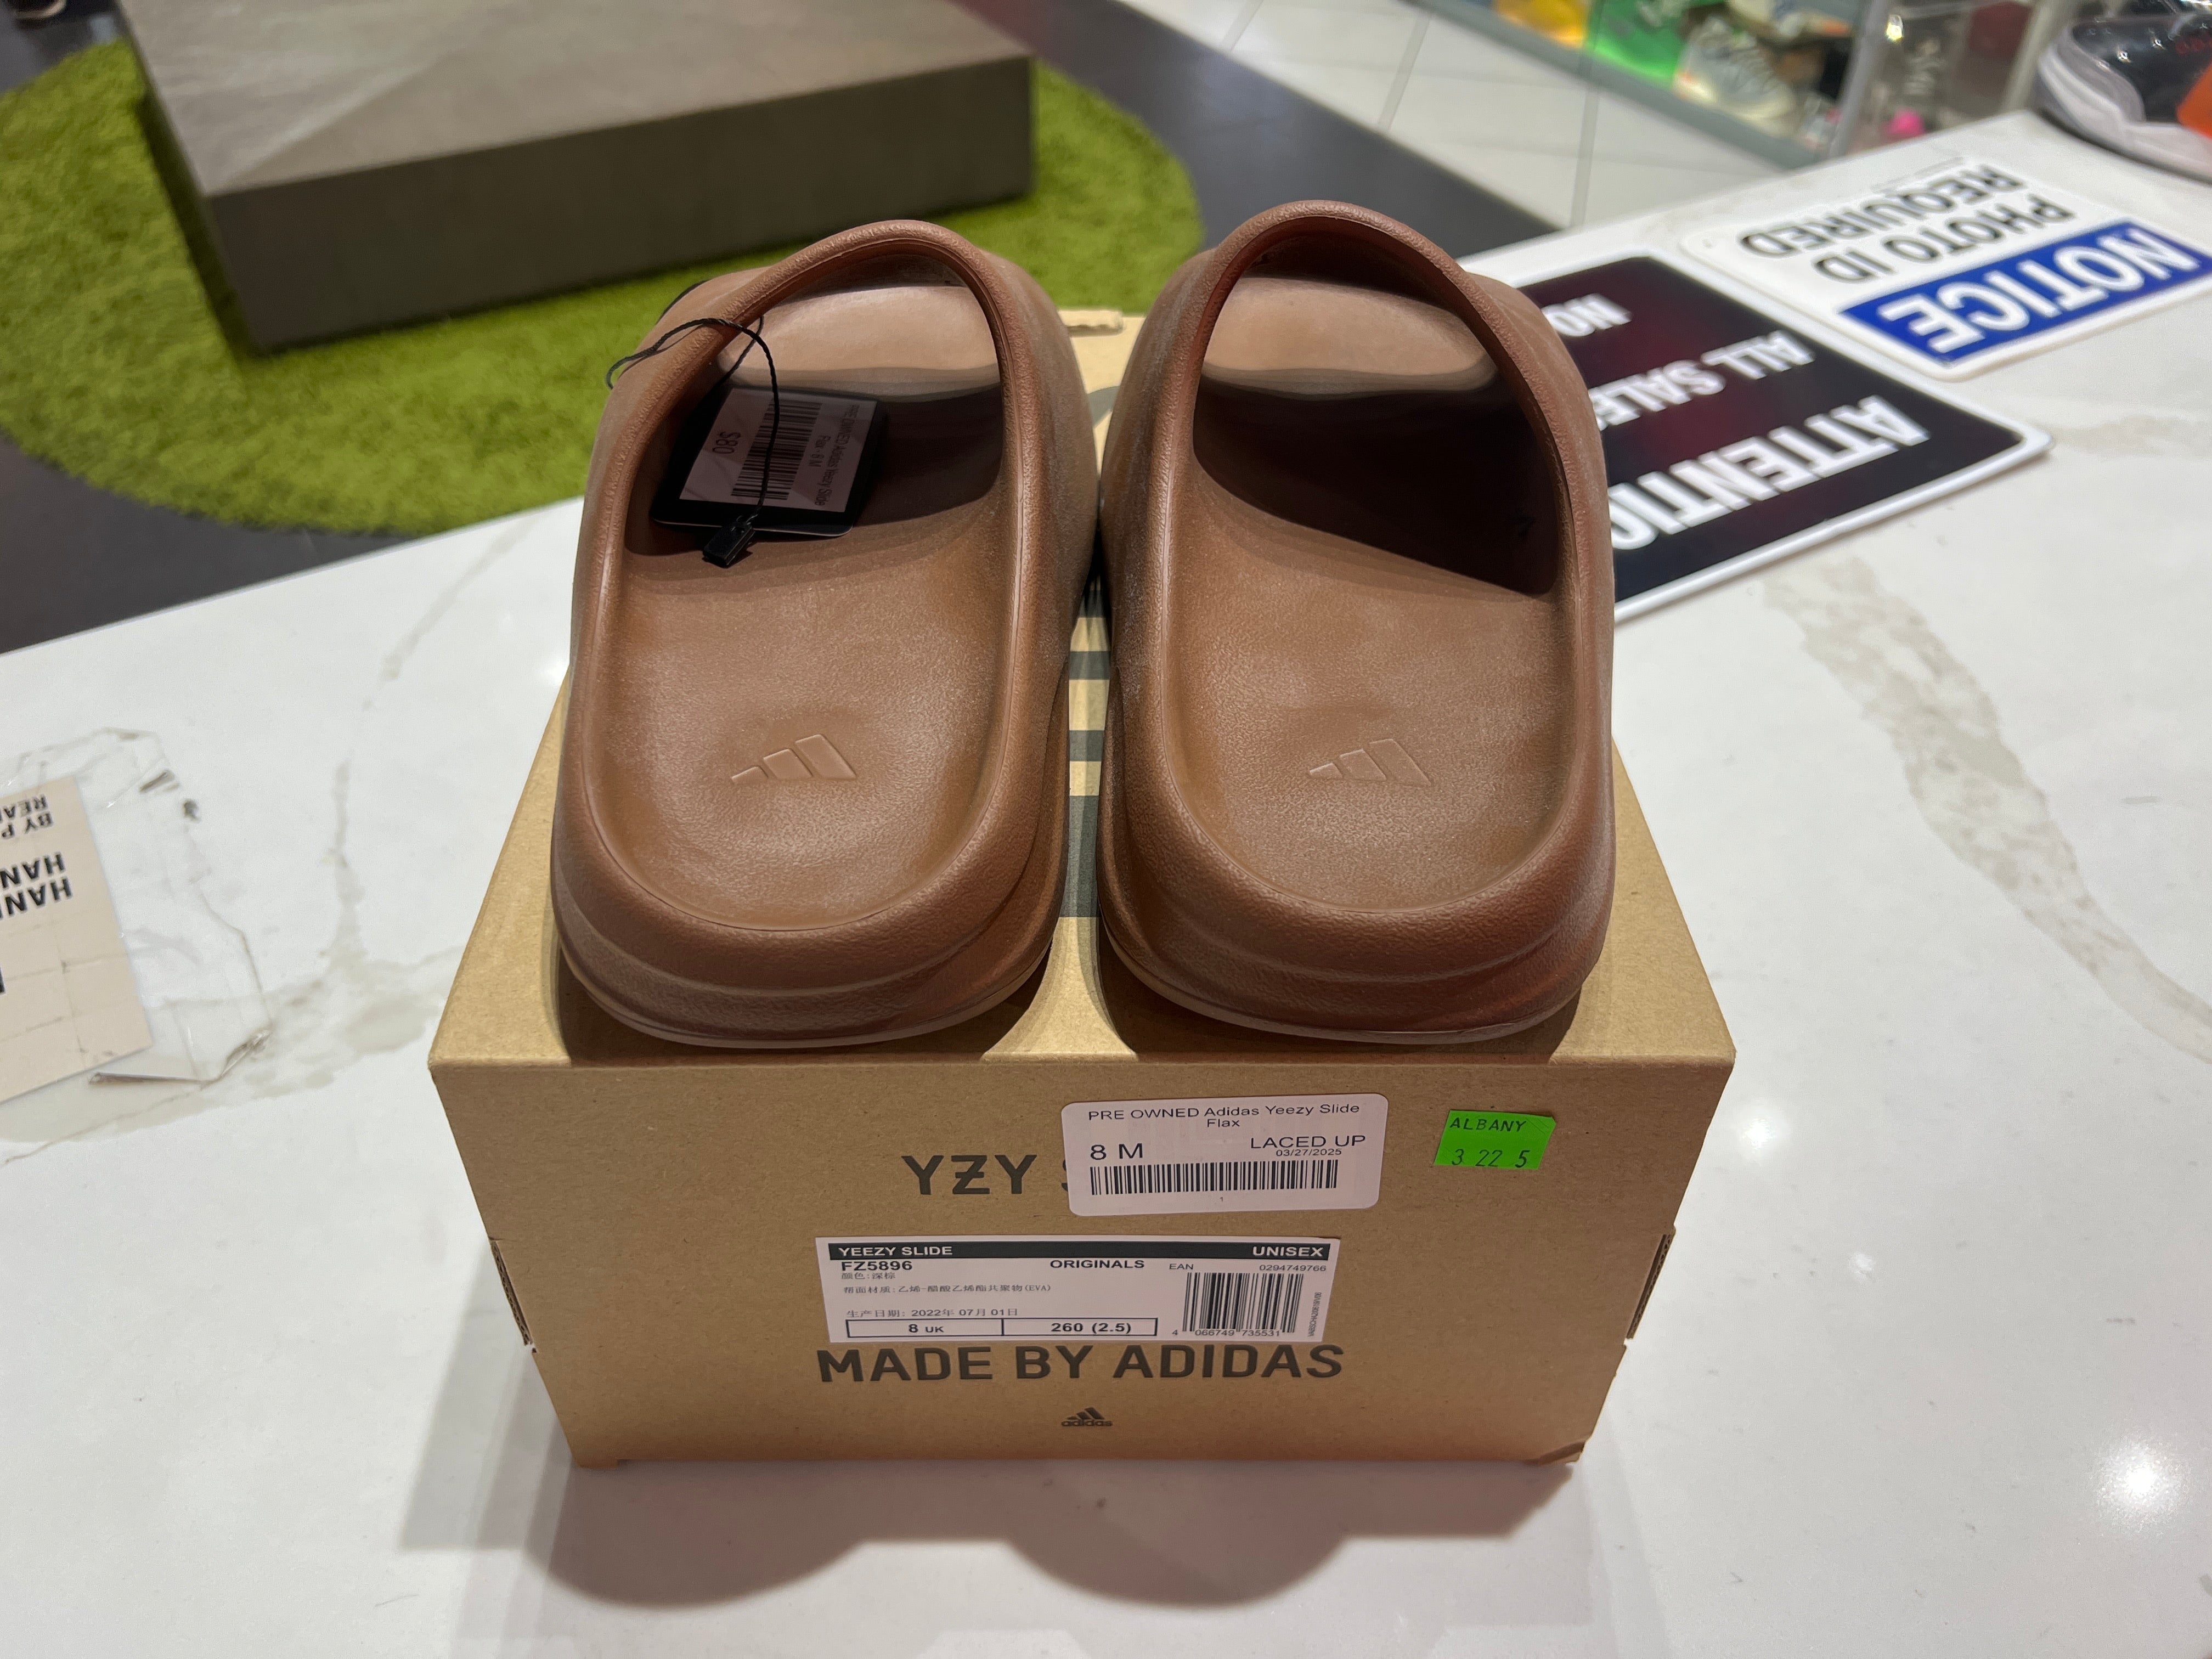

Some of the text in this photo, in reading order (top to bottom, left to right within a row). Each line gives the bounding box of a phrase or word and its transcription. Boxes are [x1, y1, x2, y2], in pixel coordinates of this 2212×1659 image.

[1739, 164, 2025, 257] REQUIRED
[1814, 193, 2077, 282] PHOTO ID
[1876, 227, 2201, 353] NOTICE
[1702, 330, 1817, 379] ALL
[713, 432, 741, 454] $80
[818, 469, 839, 487] Yeezy
[815, 488, 832, 506] Slide
[0, 794, 48, 824] REA
[25, 812, 54, 835] BY
[0, 877, 73, 921] HAN
[1088, 1103, 1360, 1120] PRE OWNED Adidas Yeezy Slide
[1207, 1118, 1240, 1128] Flax
[1450, 1117, 1526, 1132] ALBANY
[1251, 1135, 1366, 1149] LACED UP
[1090, 1143, 1144, 1160] 8 M
[1452, 1149, 1530, 1169] 3 22 5
[839, 1246, 952, 1256] YEEZY SLIDE
[1252, 1246, 1324, 1256] UNISEX
[842, 1261, 912, 1271] FZ5896
[1050, 1260, 1144, 1268] ORIGINALS
[909, 1324, 918, 1333] 8
[1051, 1323, 1131, 1333] 260 (2.5)
[816, 1344, 1344, 1382] MADE BY ADIDAS
[1062, 1418, 1113, 1427] adidas
